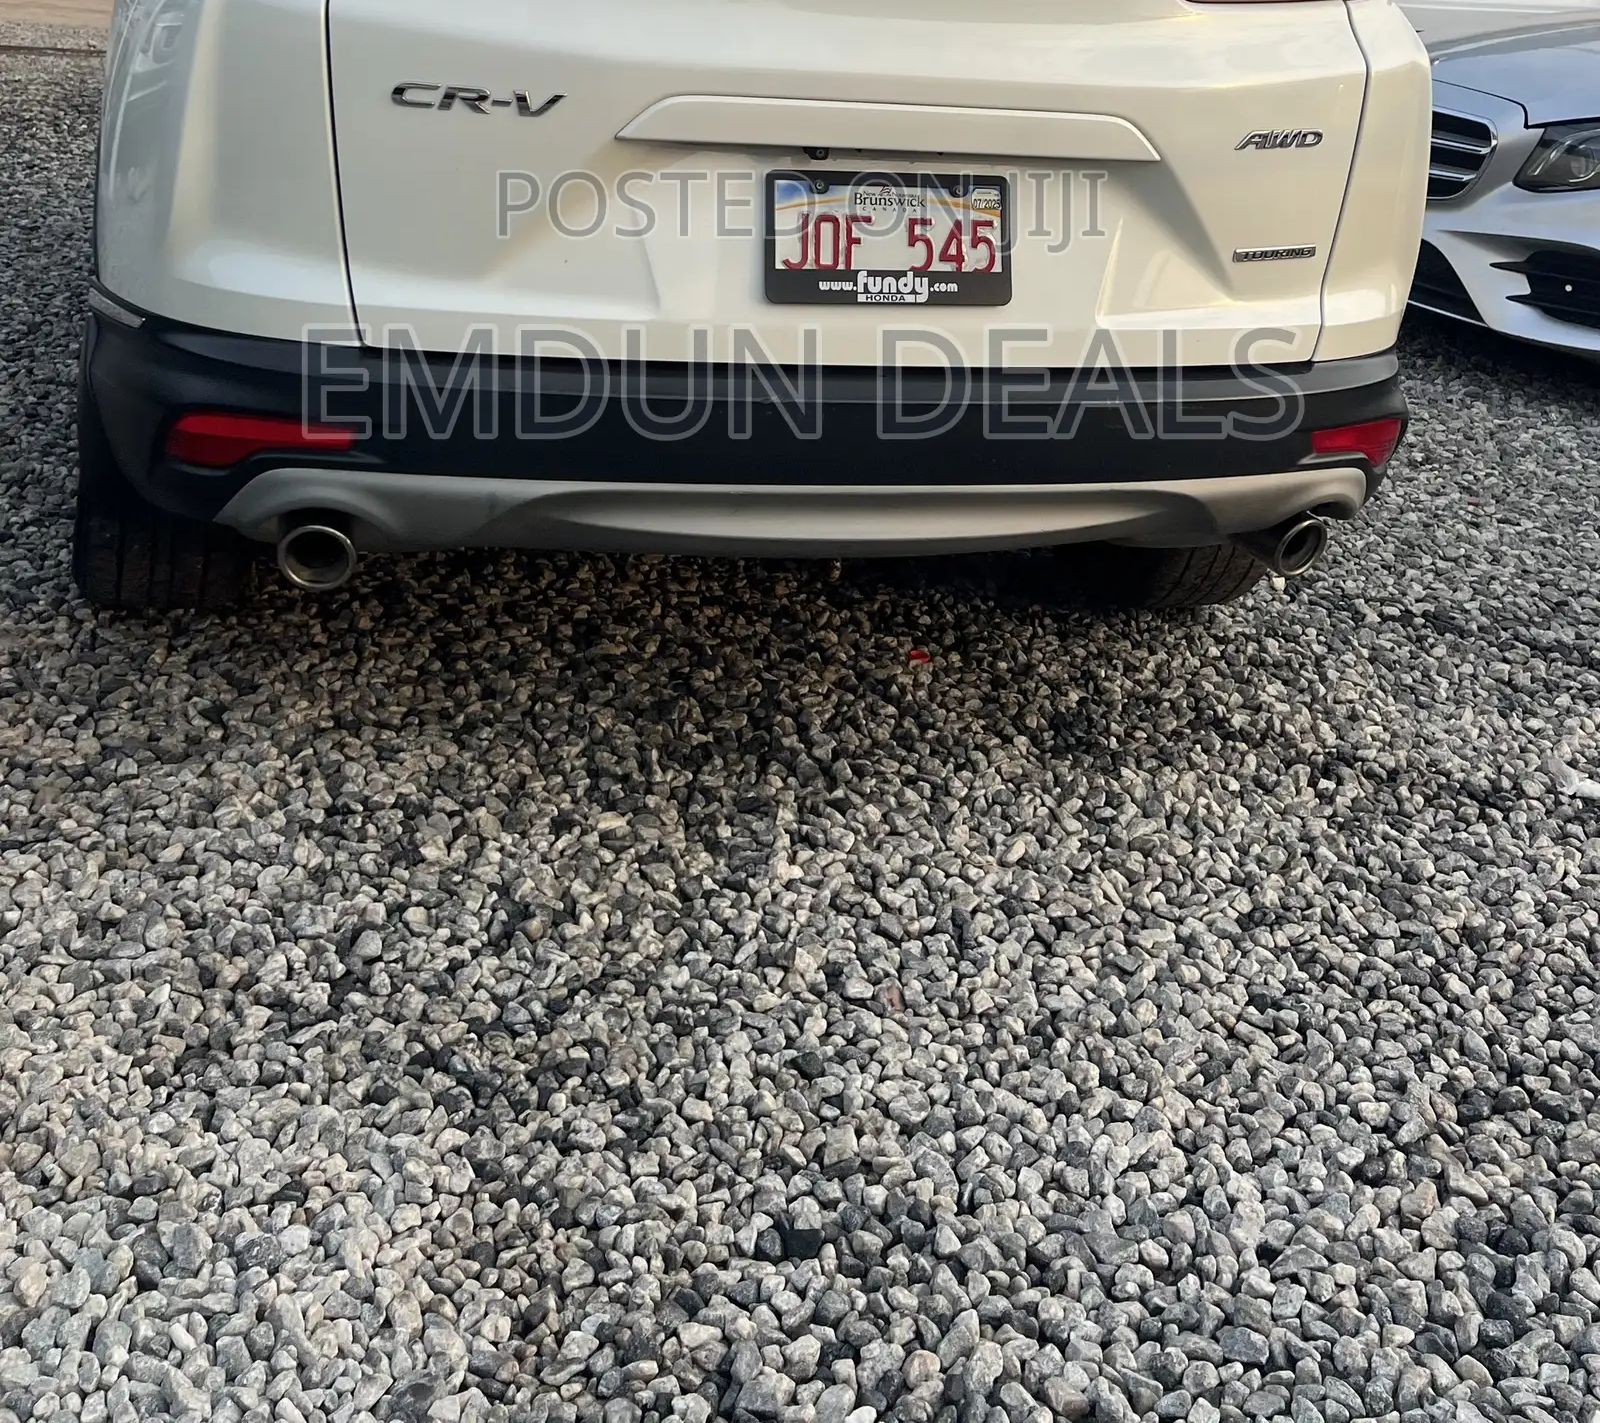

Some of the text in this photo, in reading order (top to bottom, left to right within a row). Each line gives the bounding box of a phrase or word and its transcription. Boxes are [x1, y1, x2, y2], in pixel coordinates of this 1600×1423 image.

[390, 81, 568, 117] CR-V
[1234, 129, 1324, 150] AWD
[854, 192, 926, 207] Brunswick
[782, 212, 997, 273] JOF 545
[1241, 249, 1312, 261] TOURING
[818, 271, 958, 303] www.fundy.com
[865, 293, 906, 302] HONDA
